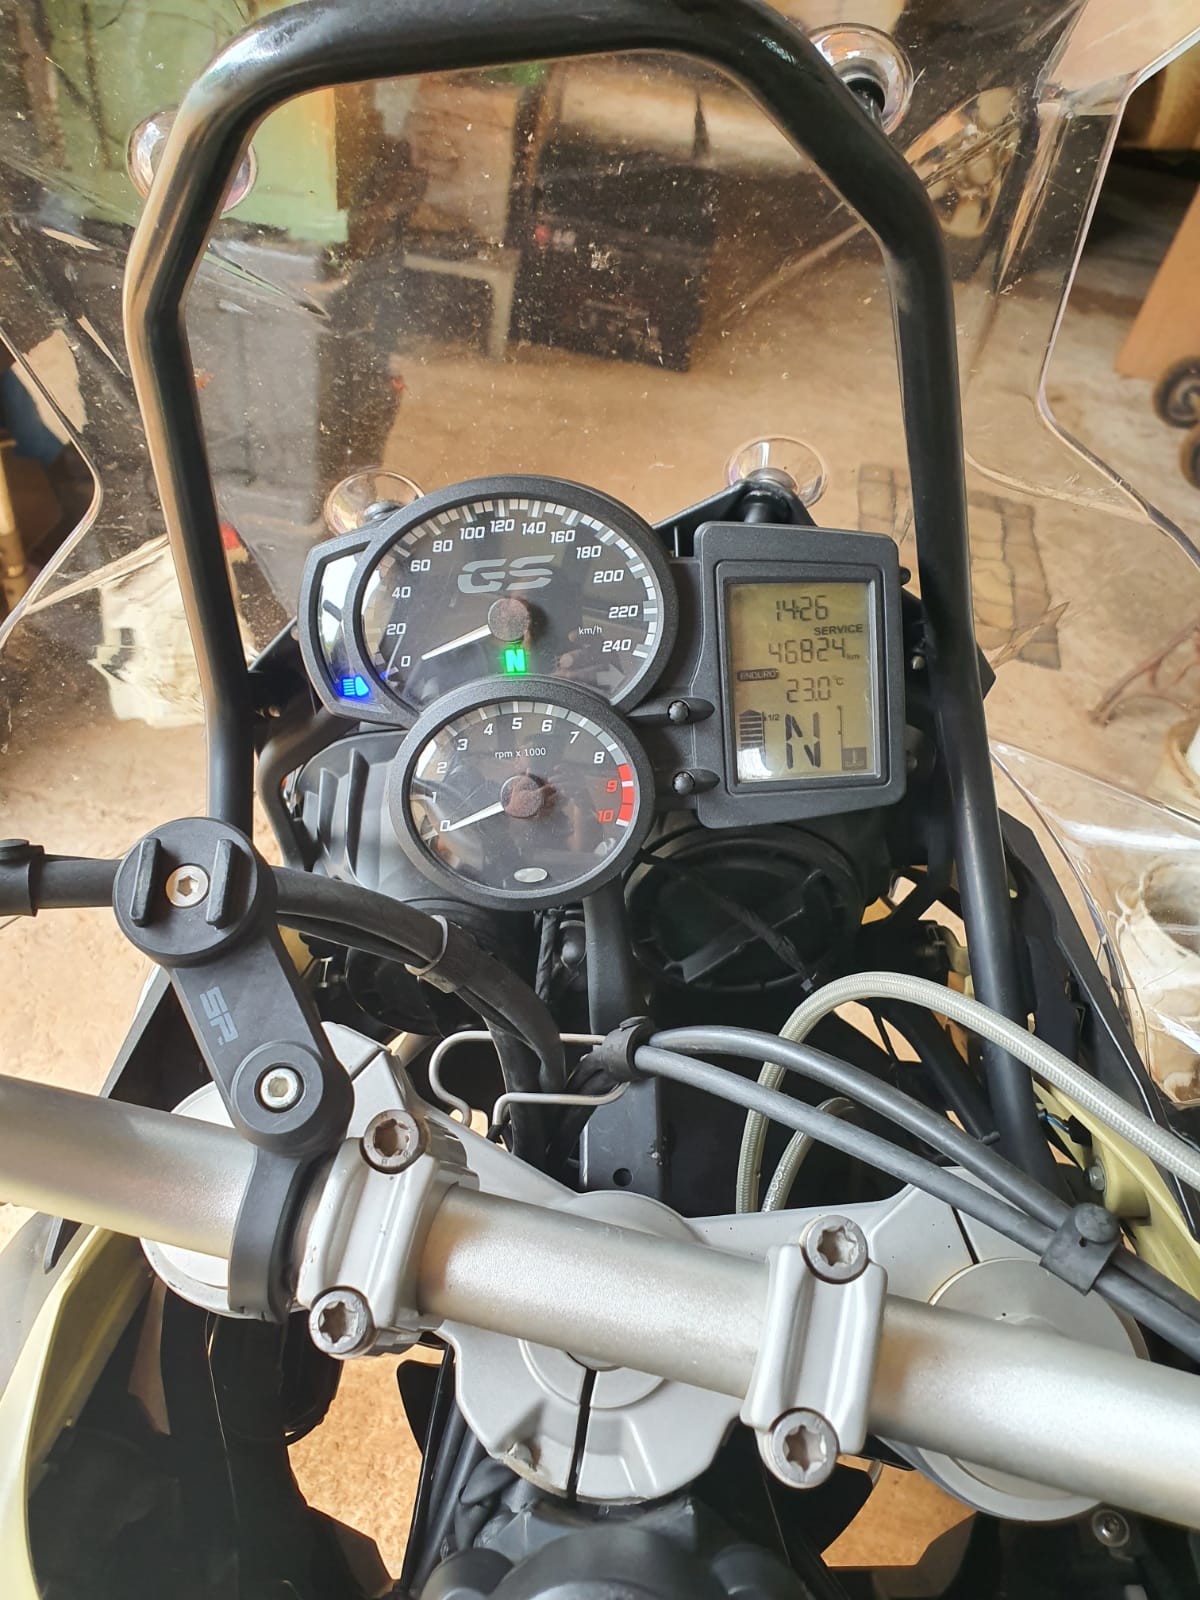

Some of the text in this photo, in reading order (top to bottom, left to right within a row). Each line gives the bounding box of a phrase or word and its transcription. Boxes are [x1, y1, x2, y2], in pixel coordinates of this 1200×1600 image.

[490, 519, 515, 533] 120
[522, 521, 546, 535] 140
[460, 526, 484, 540] 100
[551, 529, 575, 543] 160
[432, 540, 452, 553] 80
[576, 545, 602, 558] 180
[410, 559, 430, 572] 60
[458, 554, 555, 593] GS
[593, 569, 624, 583] 200
[391, 586, 411, 598] 40
[608, 604, 638, 618] 220
[387, 622, 405, 635] 20
[578, 625, 603, 635] km/h
[814, 624, 864, 636] SERVICE
[602, 639, 631, 652] 240
[768, 637, 846, 664] 46824
[401, 656, 410, 668] 0
[505, 648, 526, 673] N
[740, 670, 776, 679] ENDURO
[787, 676, 831, 703] 23.0
[483, 724, 493, 736] 4
[512, 717, 523, 730] 5
[541, 719, 552, 732] 6
[569, 731, 580, 744] 7
[785, 712, 820, 769] N
[457, 739, 468, 751] 3
[495, 749, 513, 759] rpm
[524, 748, 546, 757] 1000
[593, 751, 605, 764] 8
[437, 762, 447, 774] 2
[606, 780, 618, 792] 9
[431, 792, 437, 803] 1
[598, 810, 614, 823] 10
[440, 820, 450, 832] 0
[199, 986, 239, 1043] SP
